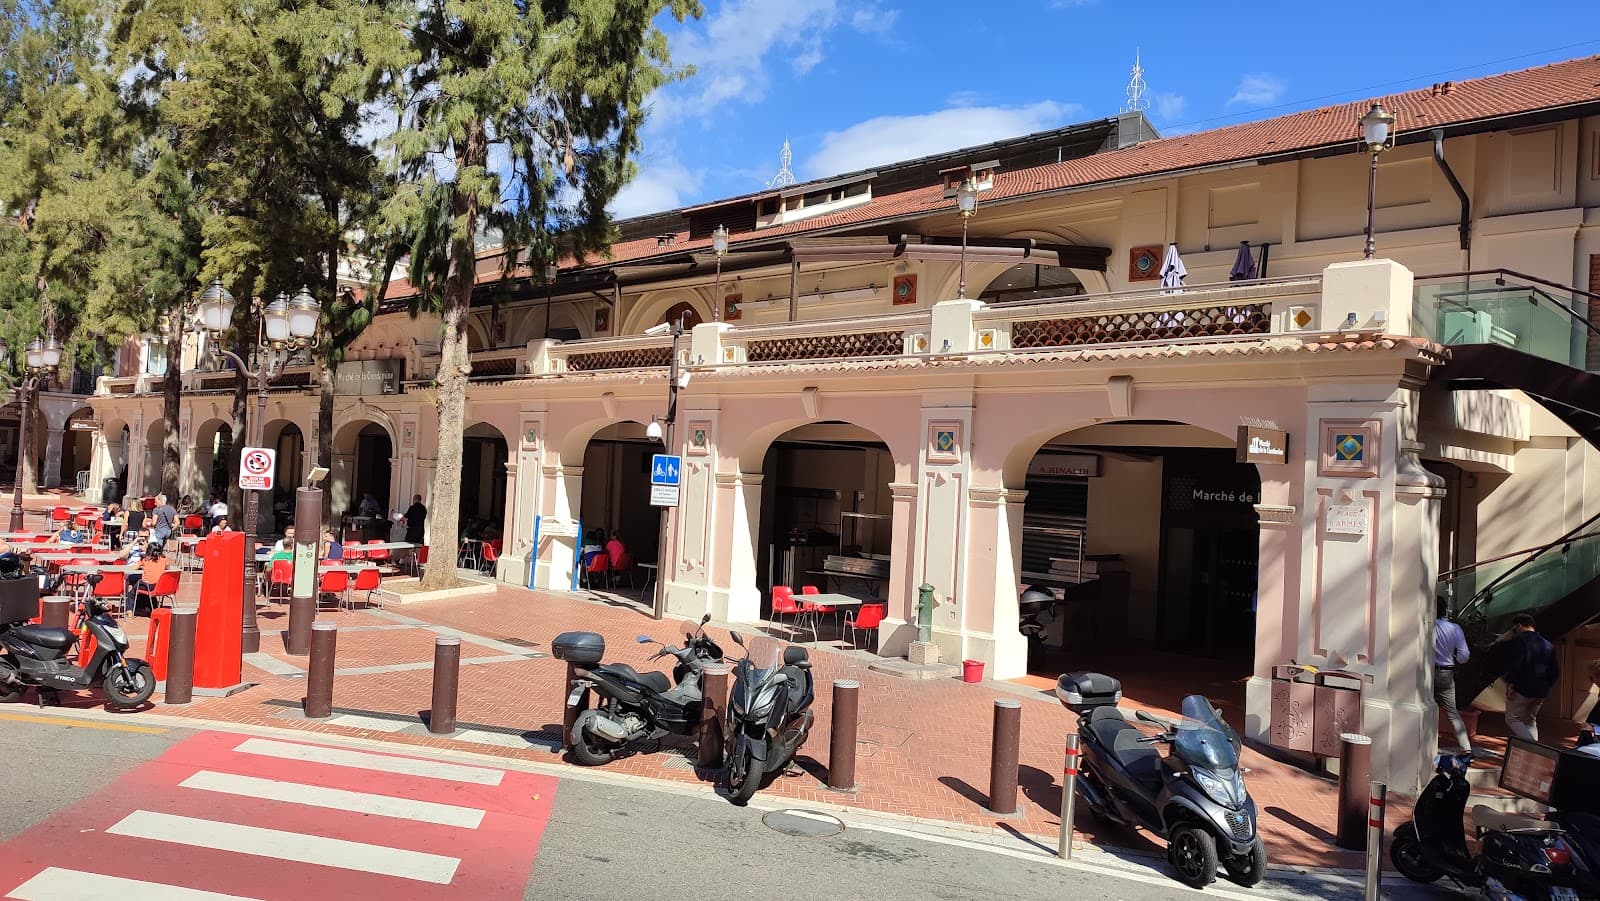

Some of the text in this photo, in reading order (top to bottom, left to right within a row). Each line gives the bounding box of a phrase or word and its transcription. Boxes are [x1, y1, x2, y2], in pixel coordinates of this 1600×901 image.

[1049, 466, 1089, 475] RINALDI
[1193, 489, 1235, 502] Marché
[1239, 491, 1253, 503] de
